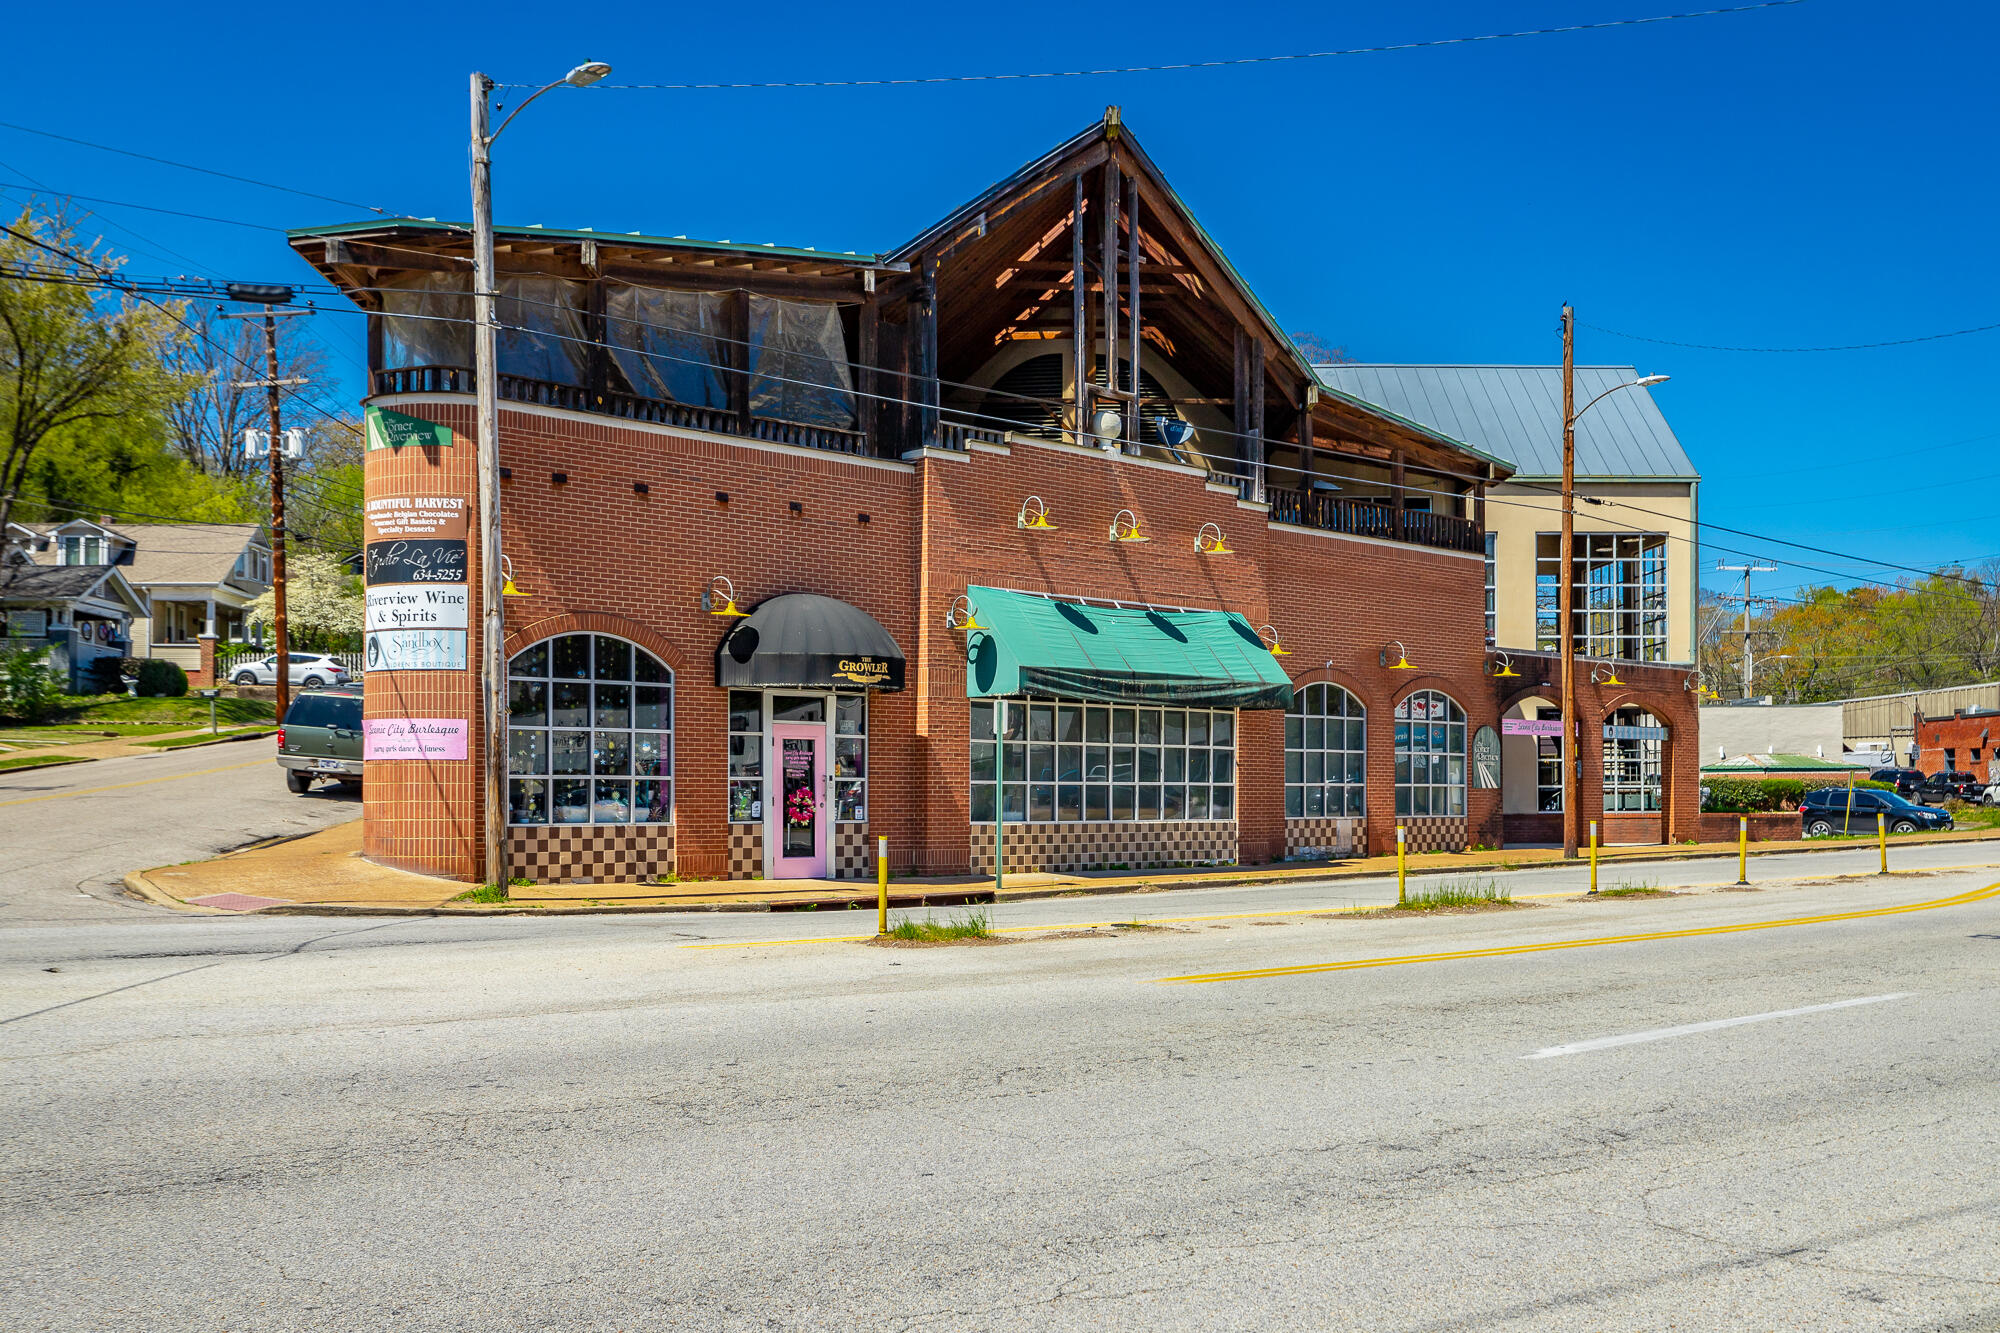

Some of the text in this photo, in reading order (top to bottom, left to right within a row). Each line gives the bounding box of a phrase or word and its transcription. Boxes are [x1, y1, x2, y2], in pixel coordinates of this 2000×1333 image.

[381, 421, 414, 432] Corner
[385, 430, 433, 442] Riverview
[370, 498, 412, 511] BOUNTIFUL
[415, 497, 464, 509] HARVEST
[394, 511, 417, 519] Belgian
[419, 510, 459, 518] Chocolates
[378, 526, 403, 535] Specialty
[403, 548, 431, 568] La
[412, 569, 463, 581] 634-5255
[367, 590, 465, 607] Riverview Wine
[378, 608, 437, 627] & Spirits
[387, 631, 447, 660] Sandbox
[839, 660, 889, 673] GROWLER
[387, 723, 406, 736] City
[407, 723, 460, 737] Burlesque
[424, 744, 446, 752] fitness
